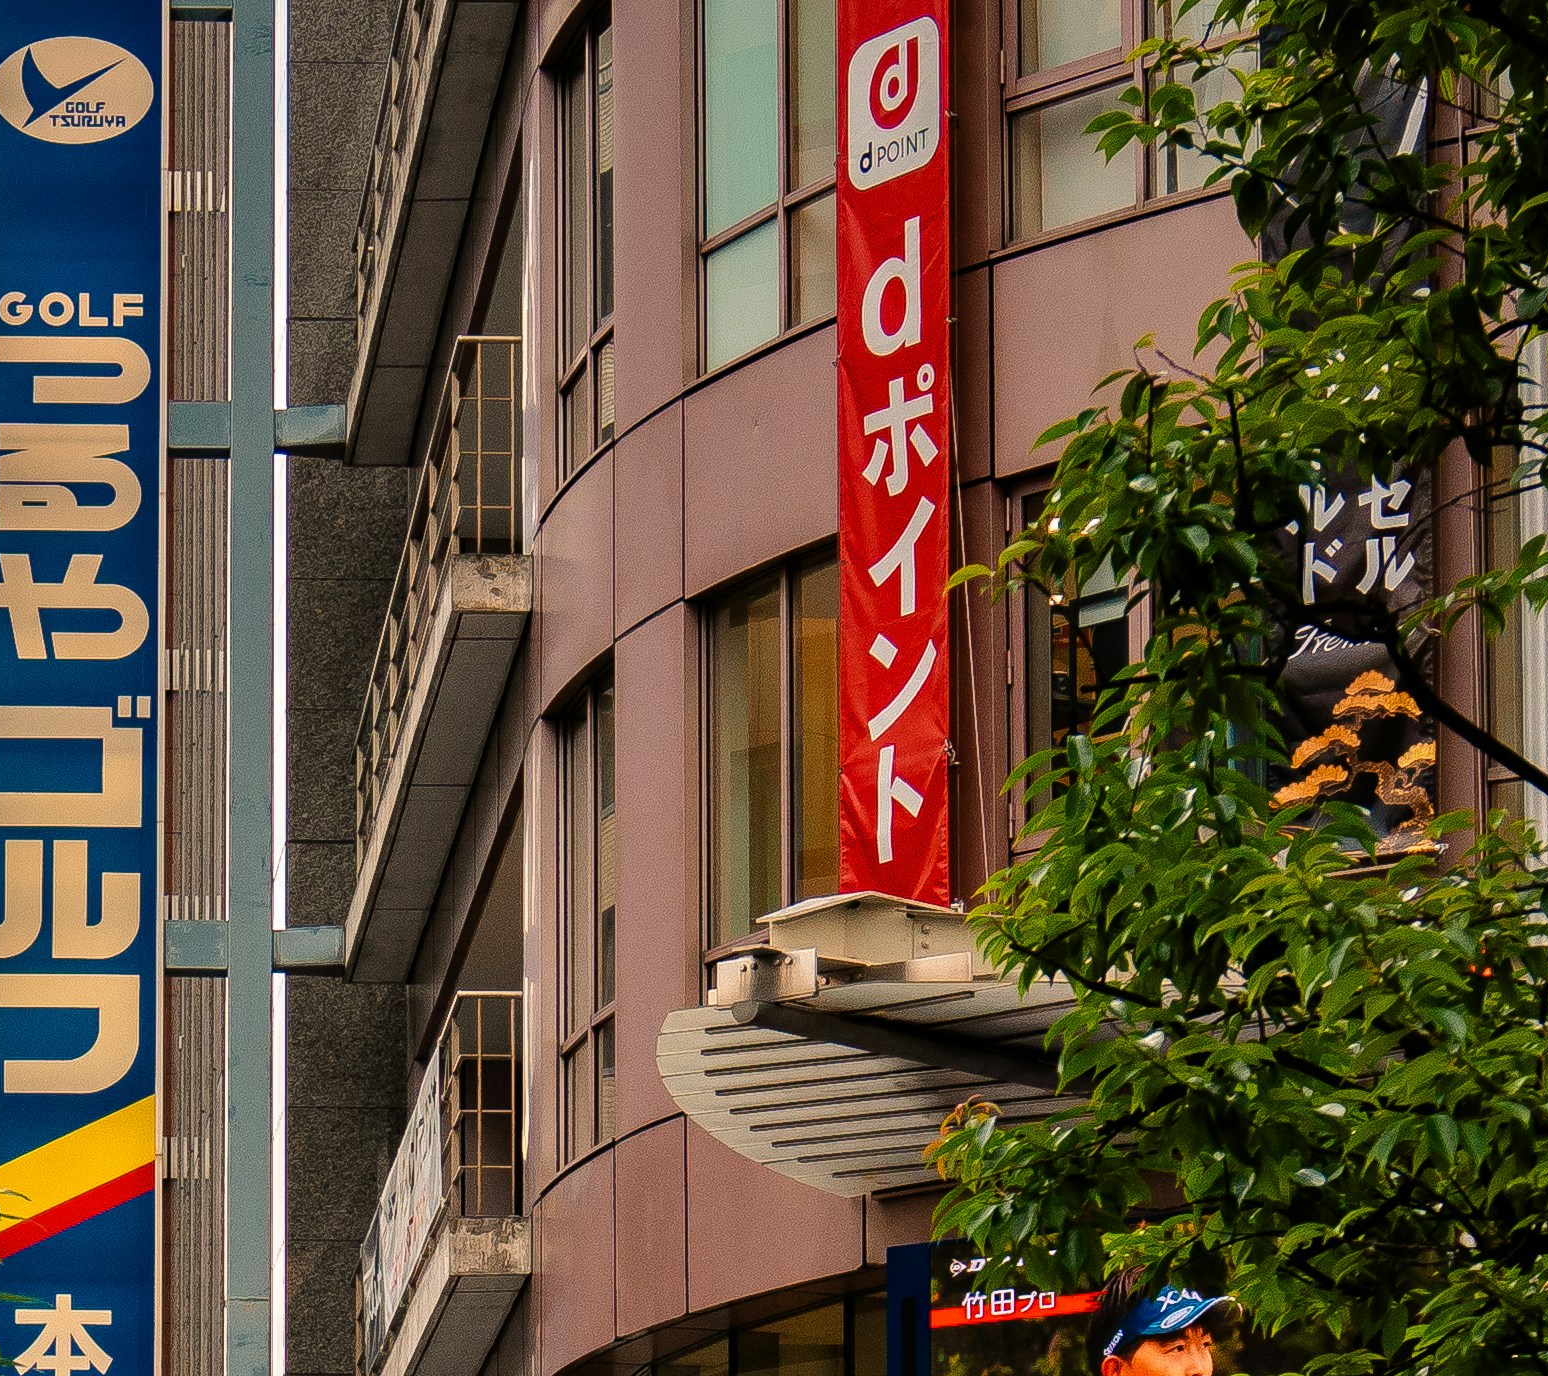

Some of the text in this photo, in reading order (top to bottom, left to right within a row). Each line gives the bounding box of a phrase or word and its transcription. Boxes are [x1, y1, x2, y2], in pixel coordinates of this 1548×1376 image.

[65, 101, 106, 115] GOLF
[50, 114, 126, 129] TSURUYA
[858, 127, 930, 174] d POINT
